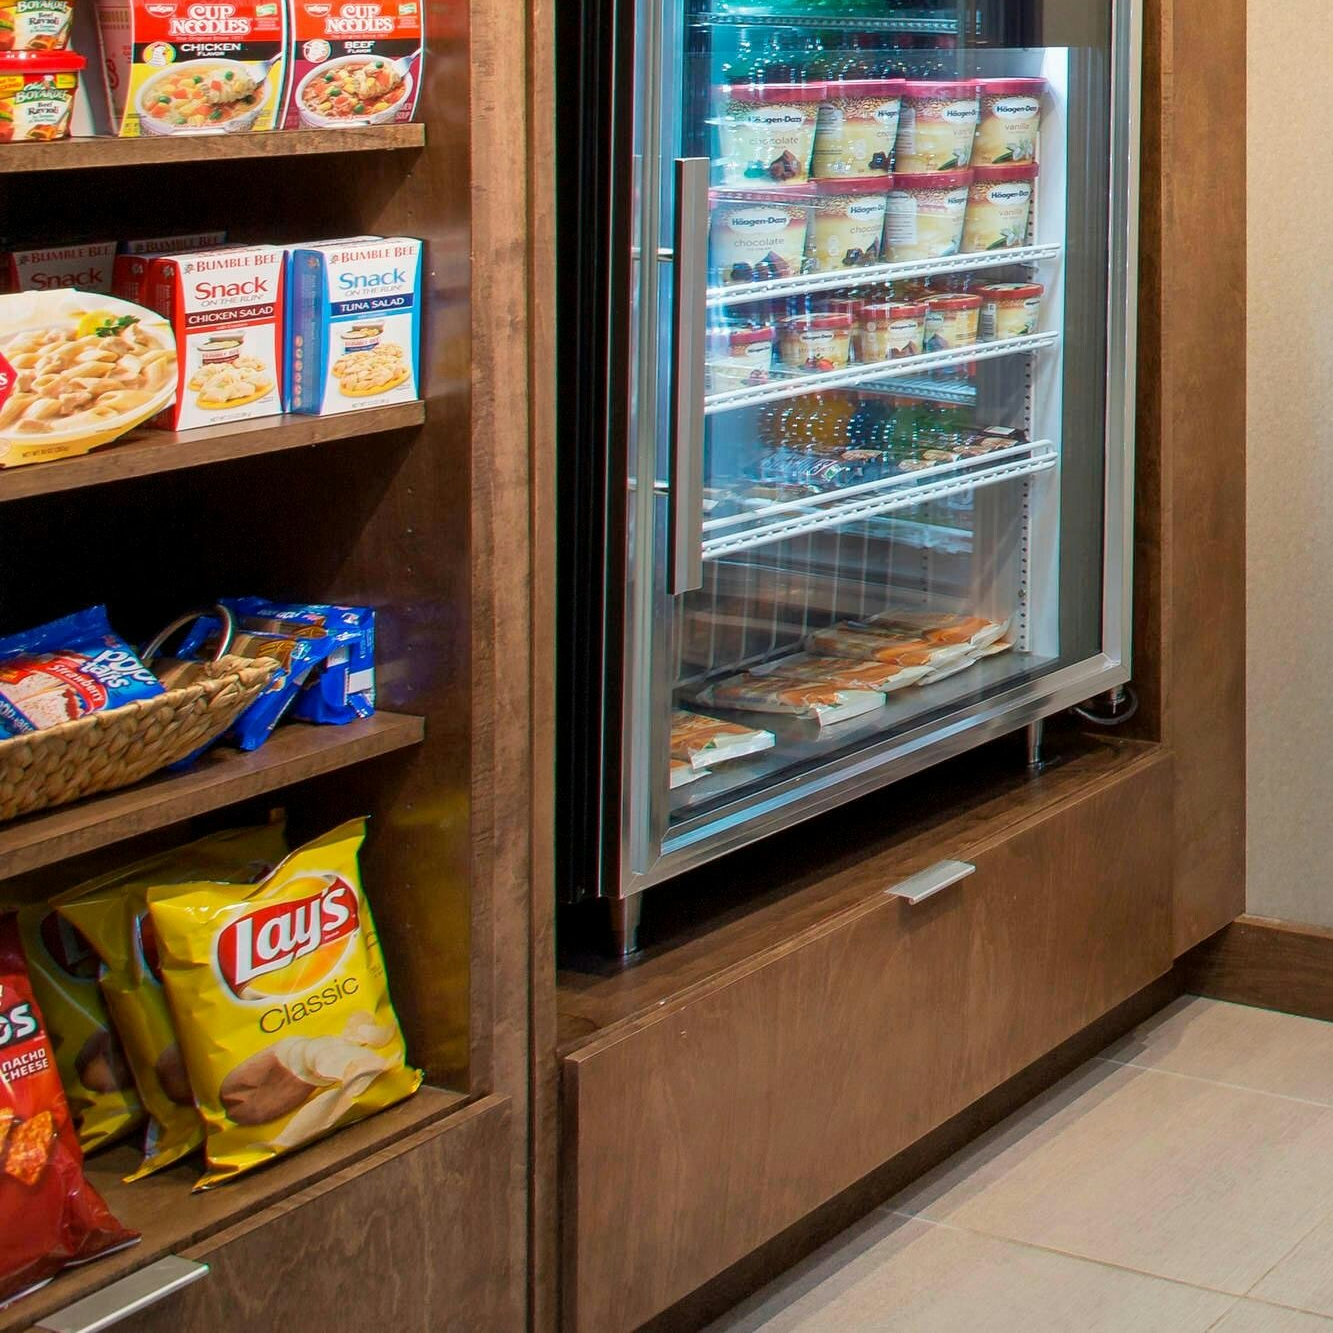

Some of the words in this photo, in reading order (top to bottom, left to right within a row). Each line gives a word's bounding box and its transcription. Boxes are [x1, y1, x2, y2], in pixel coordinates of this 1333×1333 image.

[17, 0, 69, 13] BOYARDEE
[187, 4, 236, 19] CUP
[340, 5, 381, 19] CUP
[169, 18, 252, 35] NOODLES
[325, 17, 395, 34] NOODLES
[180, 42, 242, 51] CHICKEN
[344, 40, 376, 49] BEEF
[15, 88, 69, 103] BOYARDEE
[1003, 123, 1031, 132] vanilla
[733, 237, 785, 248] chocolate
[31, 247, 87, 264] BUMBLE
[89, 244, 112, 259] BEE
[196, 255, 251, 272] BUMBLE
[254, 253, 278, 266] BEE
[341, 248, 397, 263] BUMBLE
[398, 246, 416, 258] BEE
[31, 268, 104, 290] Snack
[194, 276, 270, 299] Snack
[338, 268, 407, 291] Snack
[200, 298, 218, 307] ON
[219, 296, 238, 305] THE
[340, 302, 370, 312] TUNA
[370, 297, 405, 309] SALAD
[188, 311, 238, 324] CHICKEN
[239, 306, 274, 319] SALAD
[50, 661, 106, 704] Strawberry
[80, 660, 130, 689] tarts
[233, 885, 351, 986] Lay's
[258, 975, 360, 1035] Classic
[1, 1047, 47, 1071] NACHO
